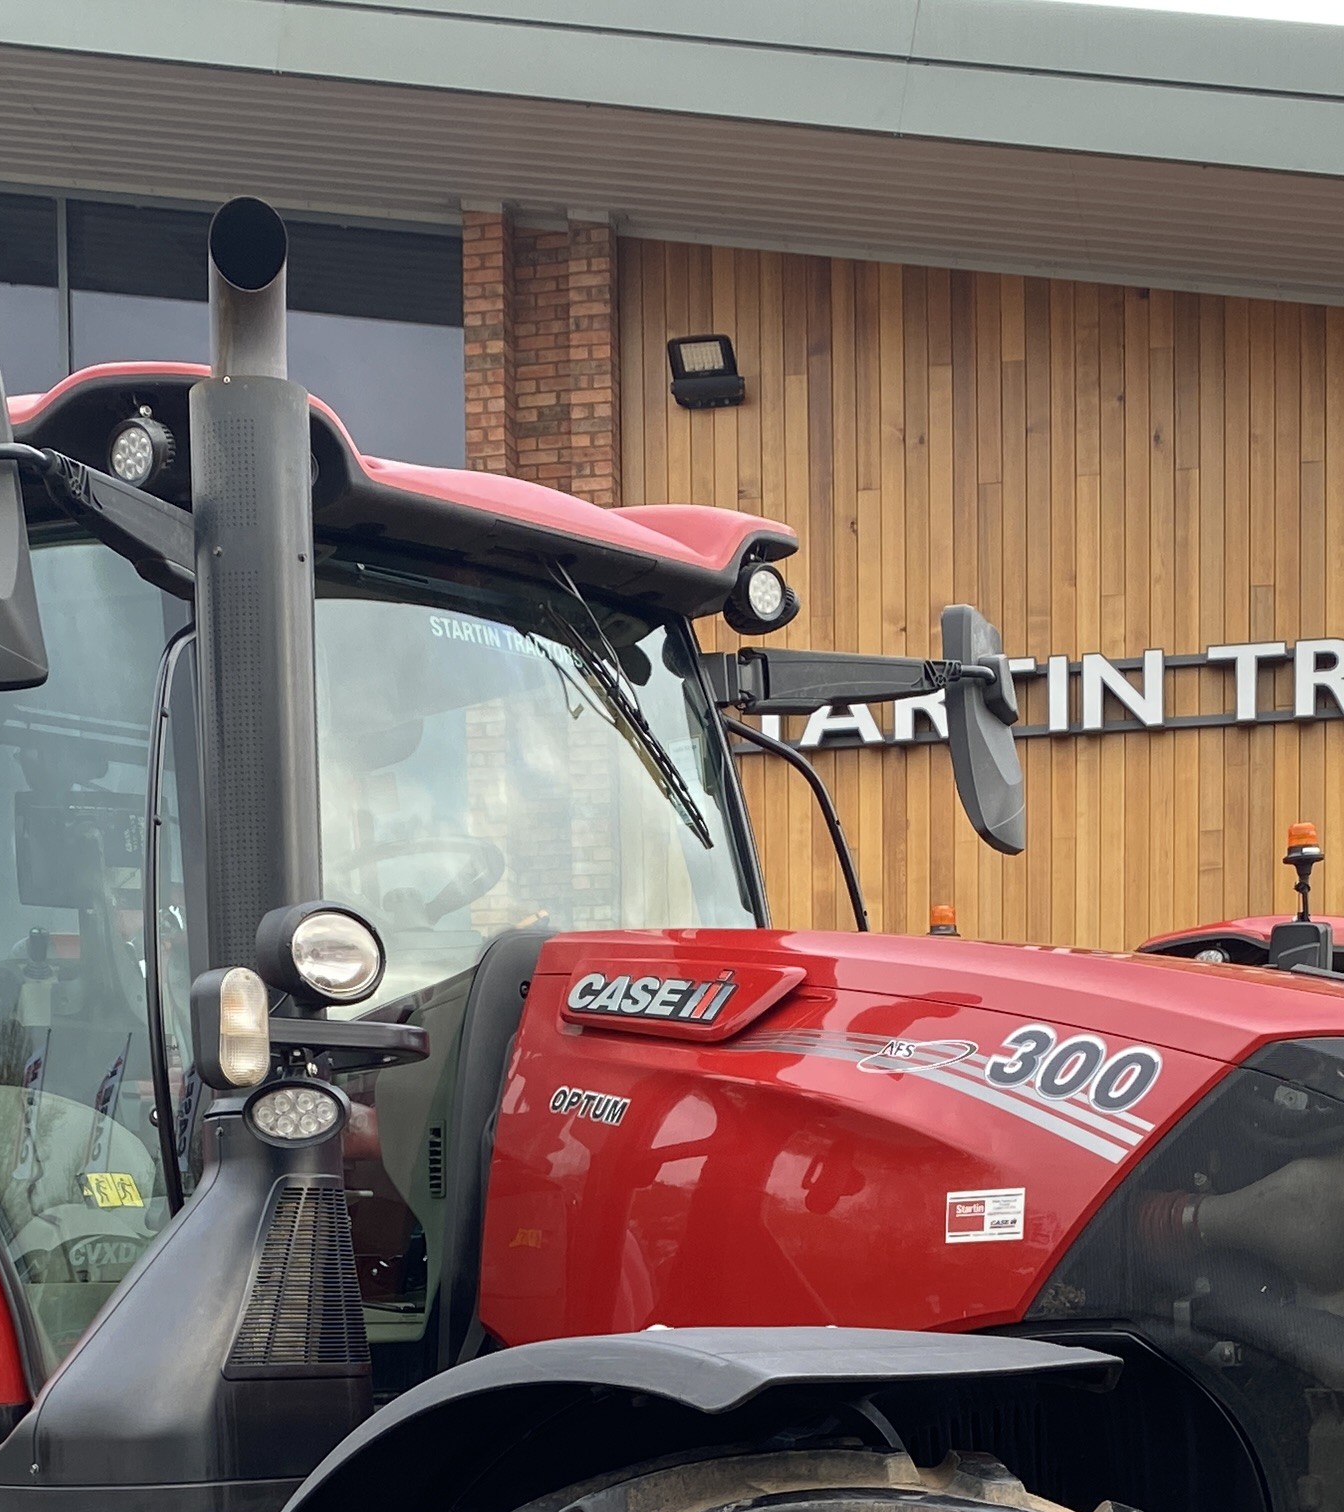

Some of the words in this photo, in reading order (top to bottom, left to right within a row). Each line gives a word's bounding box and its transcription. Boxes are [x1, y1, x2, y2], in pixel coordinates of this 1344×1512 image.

[429, 615, 501, 649] STARTIN
[503, 630, 584, 669] TRACTORS
[567, 973, 692, 1019] CASE
[881, 1040, 917, 1058] AFS
[985, 1023, 1163, 1114] 300
[549, 1085, 632, 1126] OPTUM
[956, 1203, 984, 1214] Startin
